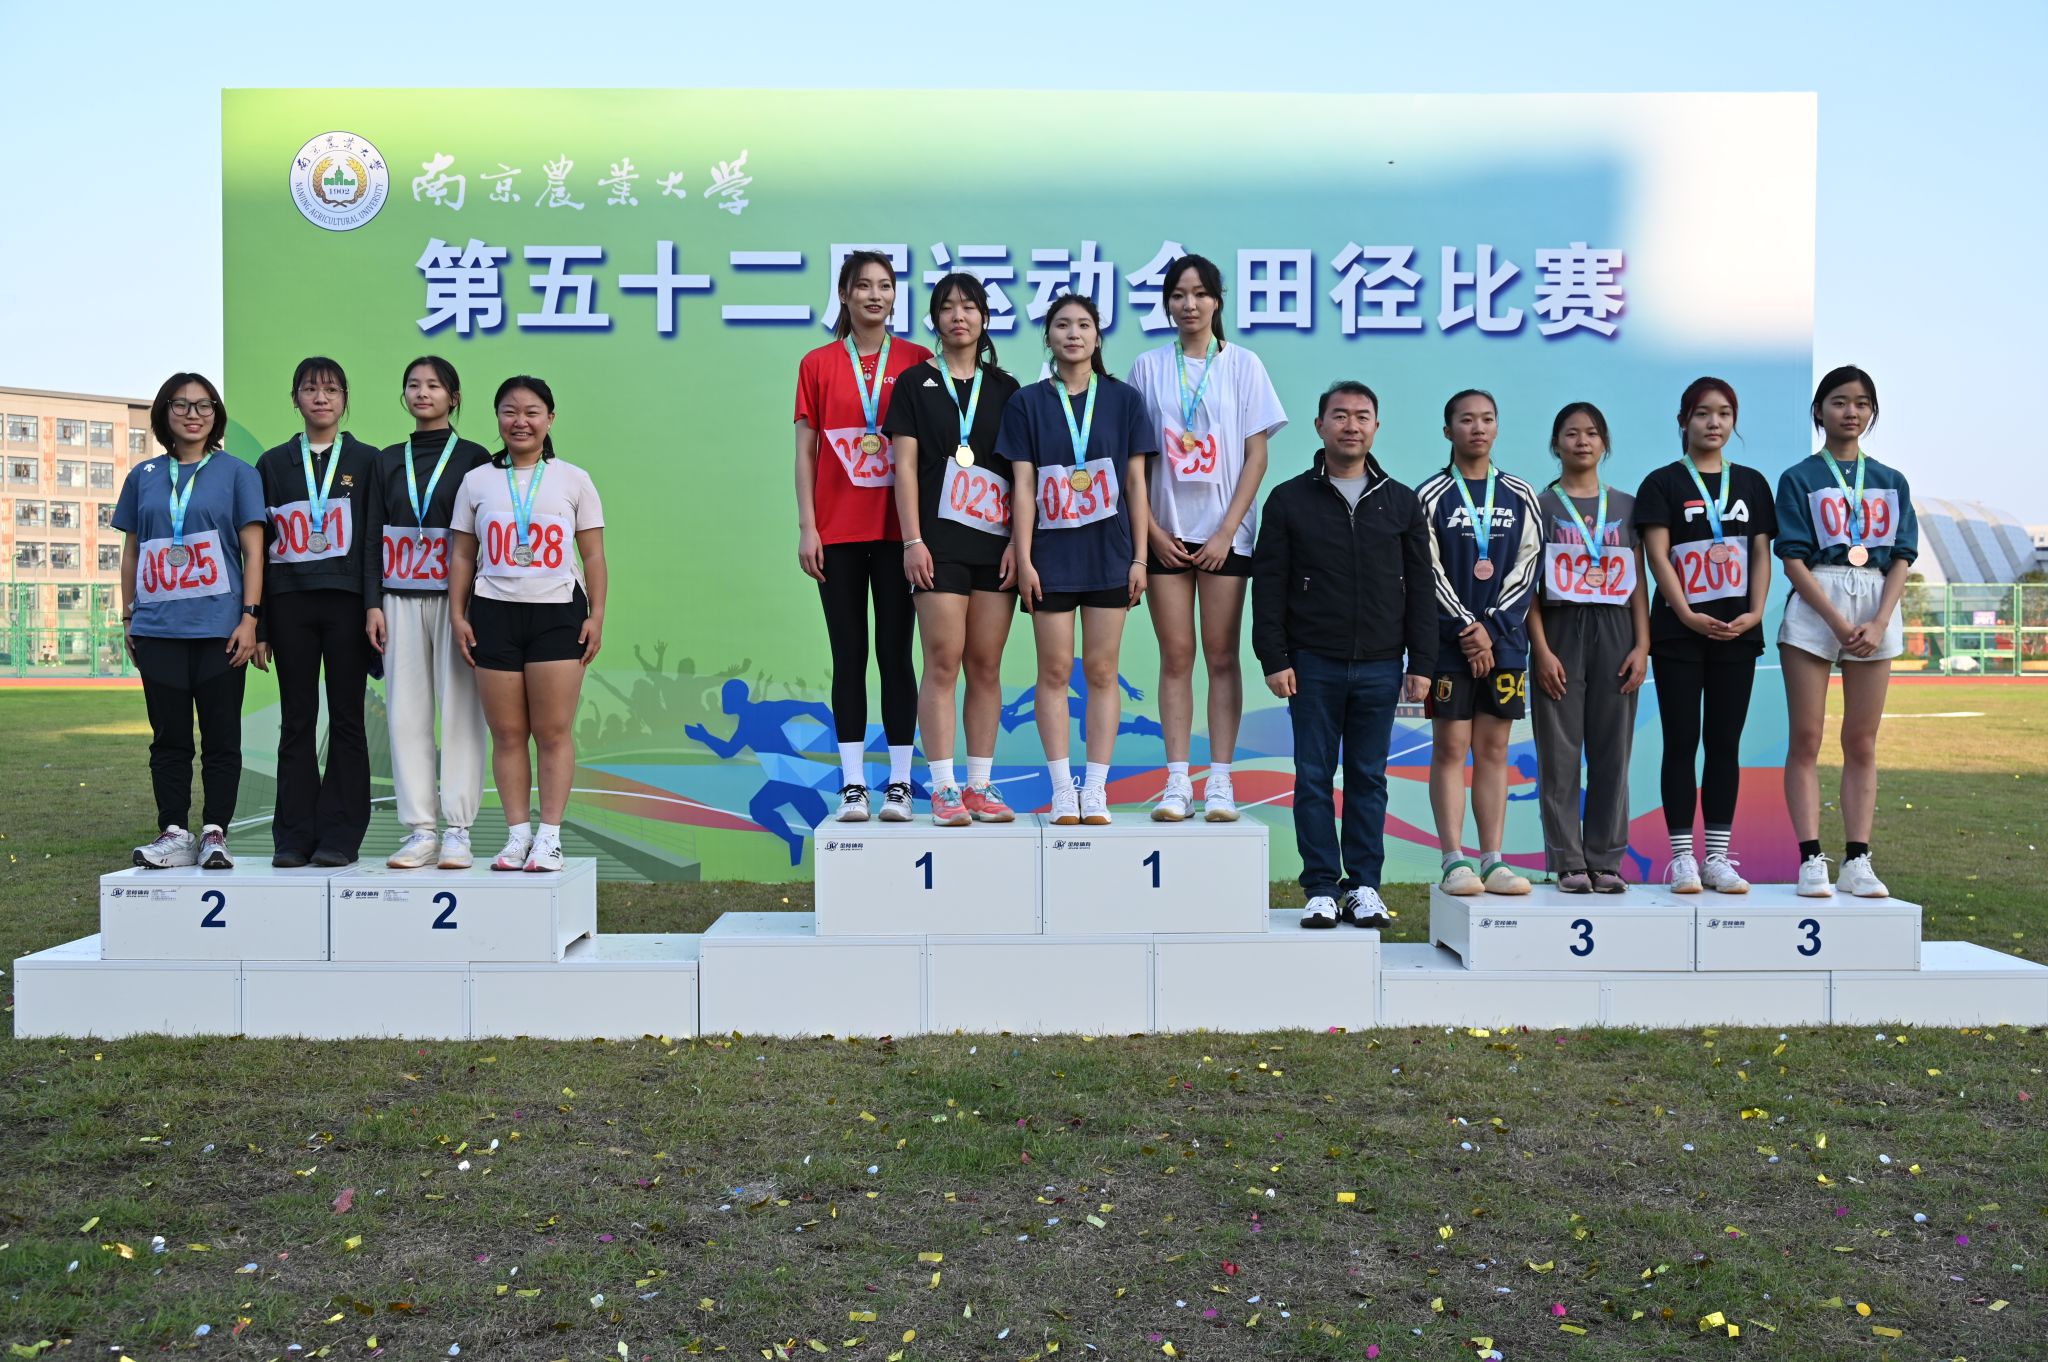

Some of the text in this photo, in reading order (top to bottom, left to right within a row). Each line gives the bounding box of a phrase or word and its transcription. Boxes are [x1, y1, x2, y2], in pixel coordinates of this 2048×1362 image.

[308, 207, 361, 226] AGRICULTURAL
[358, 182, 384, 219] UNIVERSITY
[1043, 469, 1110, 521] 0231
[1683, 499, 1749, 522] FLA
[383, 535, 449, 580] 0023
[487, 521, 564, 569] 0028
[143, 541, 218, 594] 0025
[1554, 552, 1628, 596] 0212
[915, 852, 933, 889] 1
[1143, 851, 1160, 888] 1
[201, 890, 226, 928] 2
[432, 892, 457, 929] 2
[1570, 919, 1595, 957] 3
[1797, 919, 1822, 957] 3
